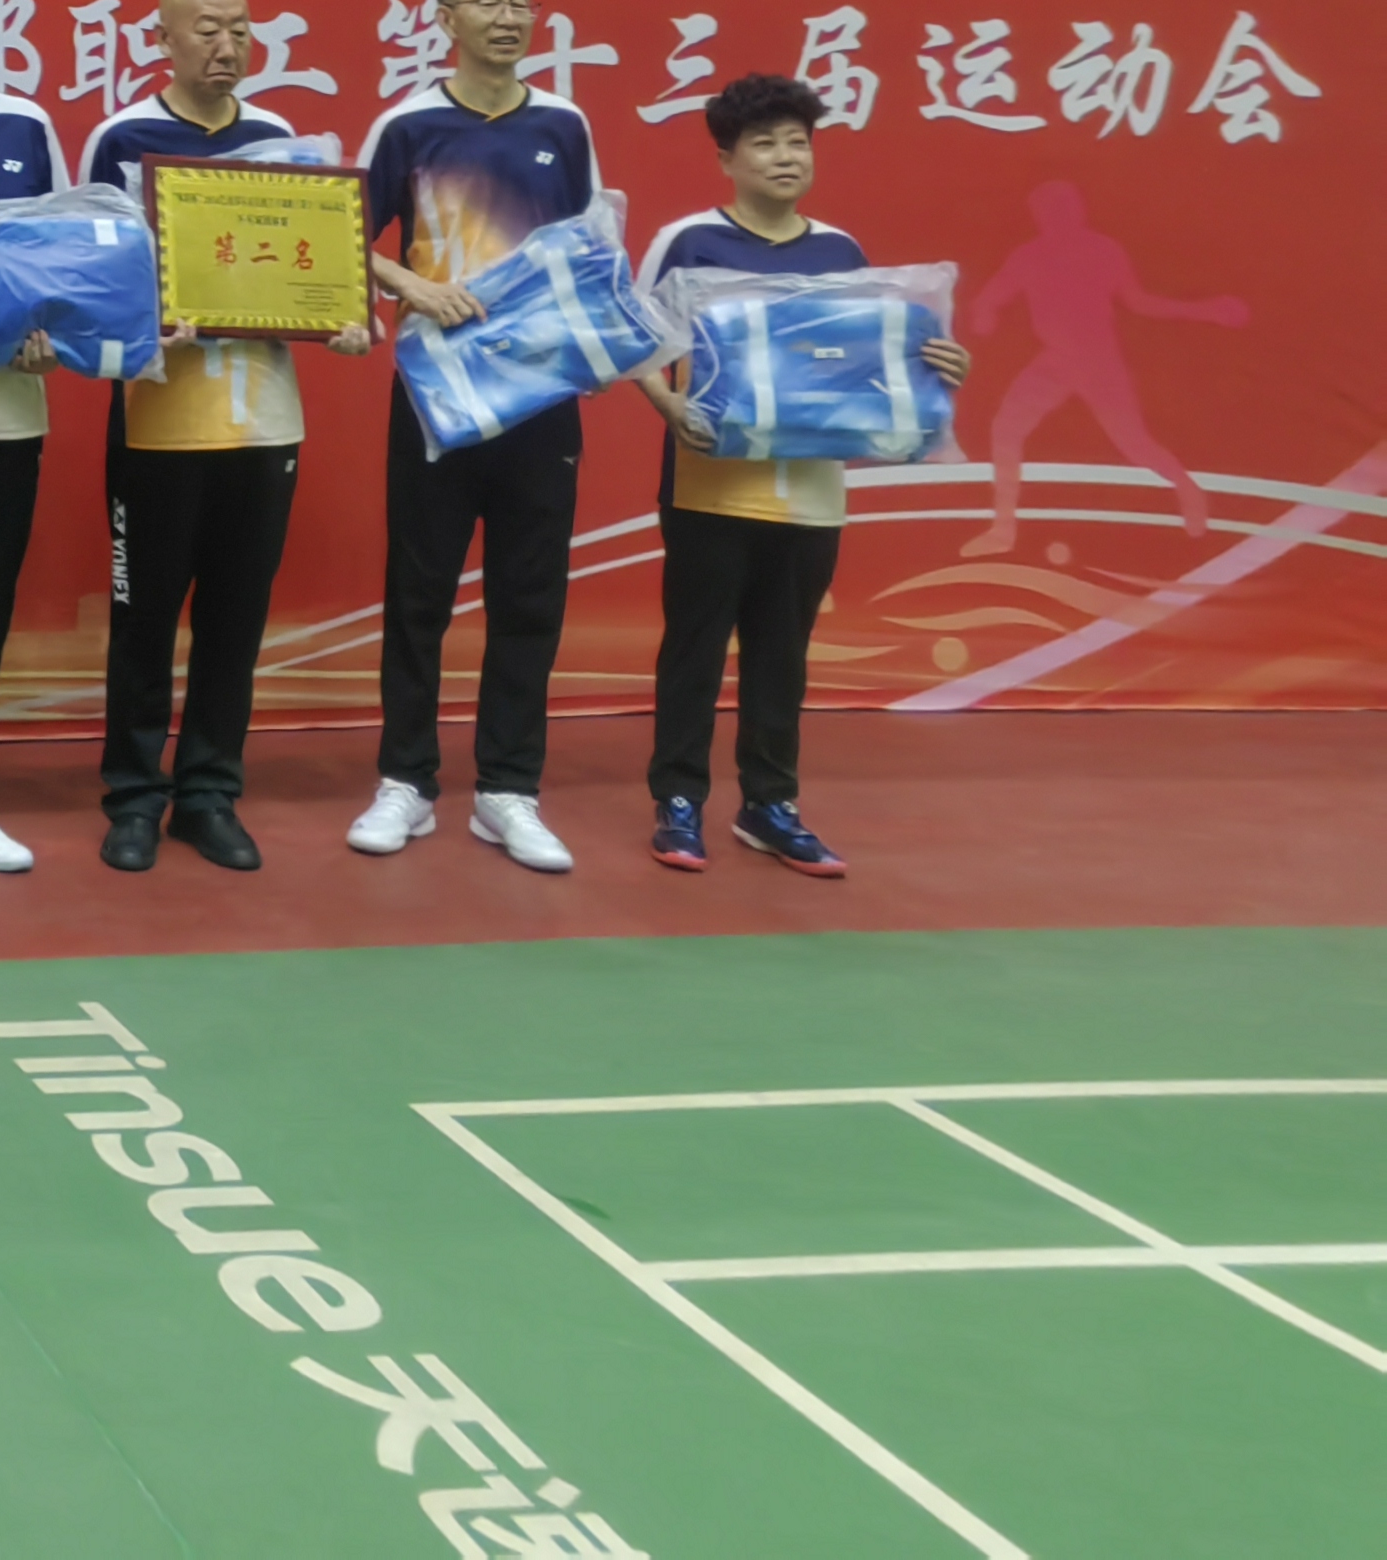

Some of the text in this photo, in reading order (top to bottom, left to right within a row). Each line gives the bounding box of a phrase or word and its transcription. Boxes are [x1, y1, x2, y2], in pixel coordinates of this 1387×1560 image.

[213, 231, 314, 270] 第二名
[111, 538, 131, 606] YONEX
